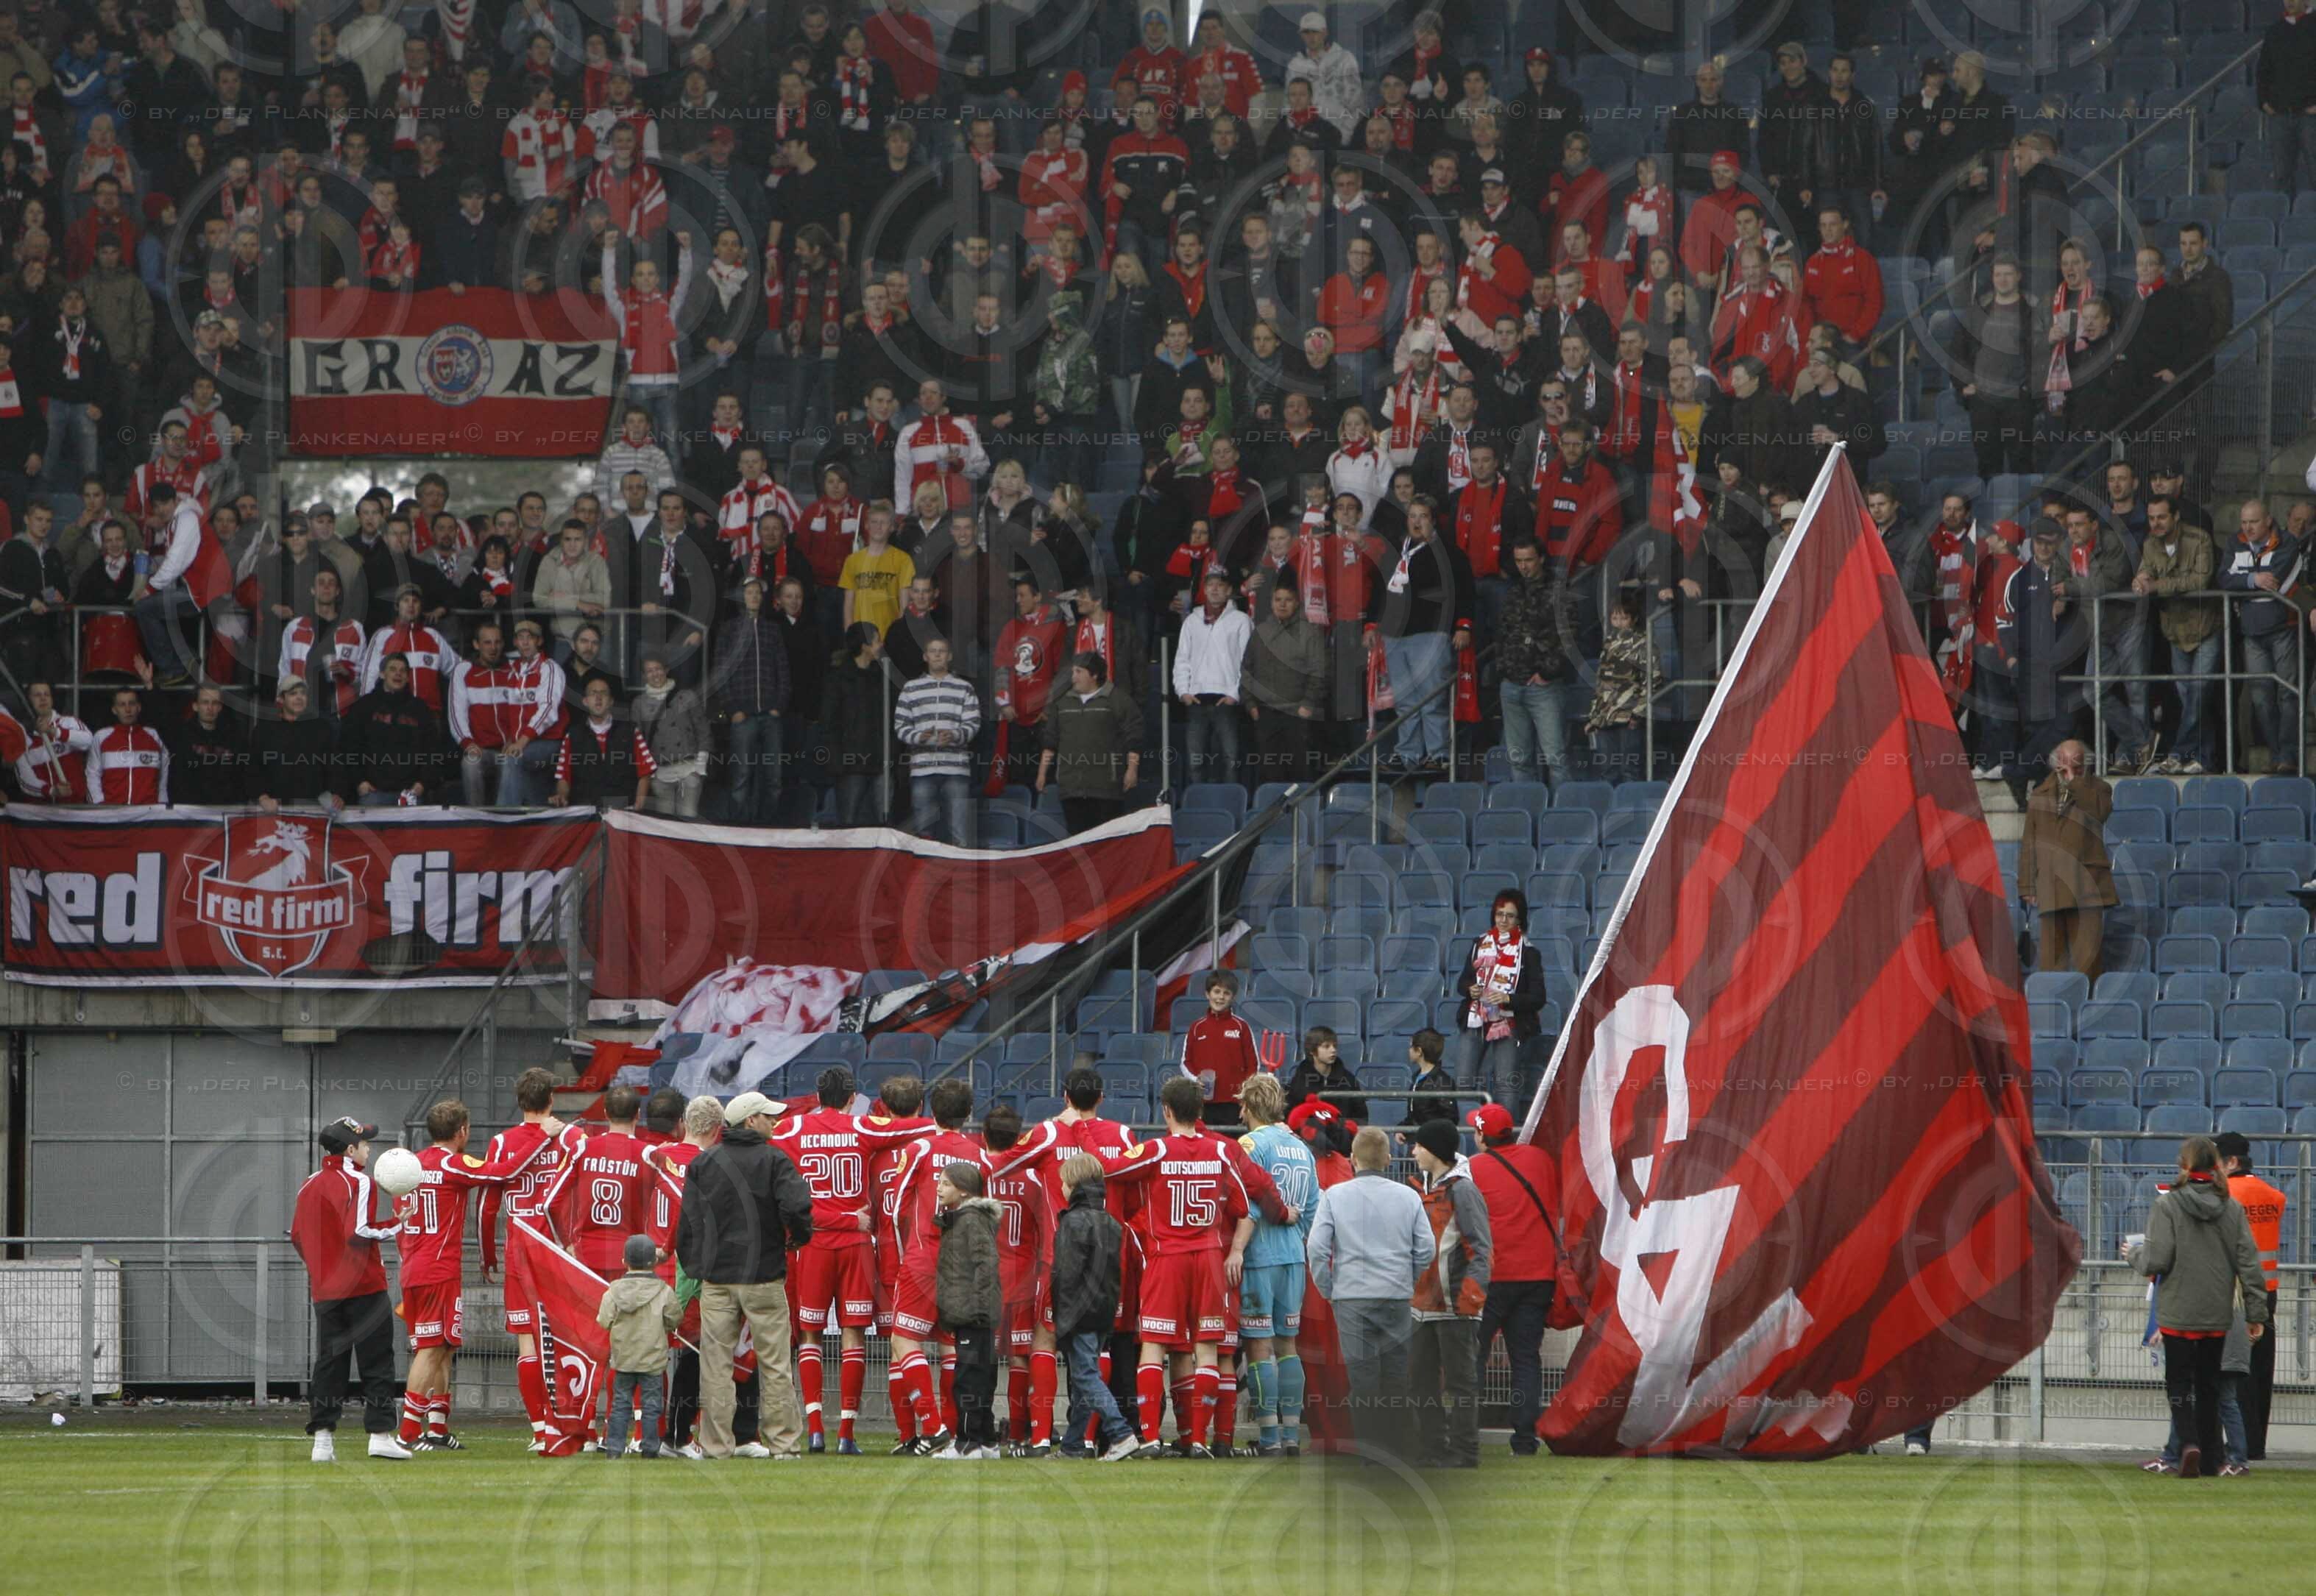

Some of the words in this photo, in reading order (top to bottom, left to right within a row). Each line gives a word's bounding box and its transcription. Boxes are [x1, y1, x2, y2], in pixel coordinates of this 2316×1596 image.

[9, 852, 160, 943] red
[384, 850, 581, 944] firm
[207, 893, 263, 928] red
[271, 895, 344, 930] firm
[800, 1153, 863, 1199] 20
[1161, 1160, 1222, 1175] DEUTSCHMANN
[1271, 1163, 1311, 1212] 30
[591, 1178, 623, 1225] 8
[1167, 1180, 1217, 1227] 15
[897, 1316, 932, 1333] WOCHE
[1141, 1319, 1176, 1332] WOCHE
